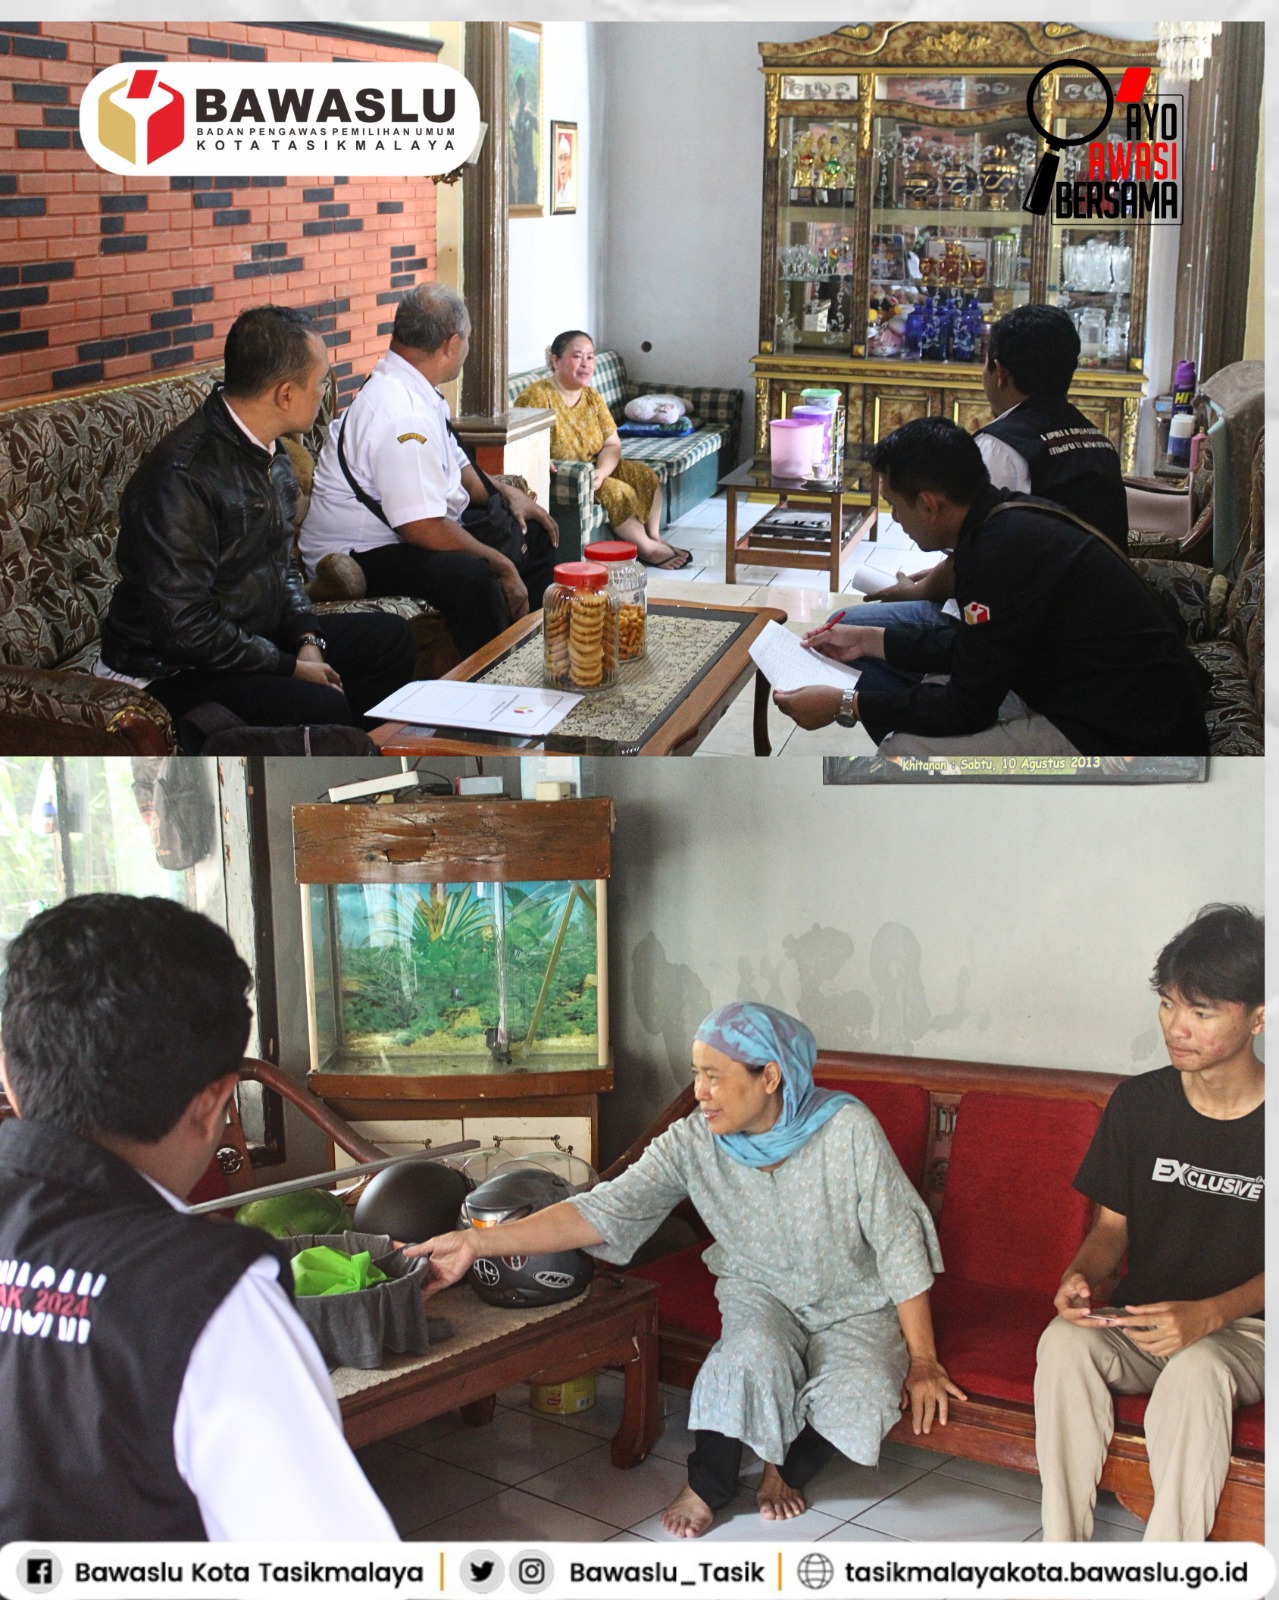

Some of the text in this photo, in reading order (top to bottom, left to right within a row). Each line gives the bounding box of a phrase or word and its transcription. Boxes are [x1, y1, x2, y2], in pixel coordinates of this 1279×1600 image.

[902, 759, 947, 772] Khitanan
[960, 758, 996, 772] Sabtu,
[1002, 757, 1017, 769] 10
[1021, 757, 1066, 772] Agustus
[1071, 756, 1101, 768] 2013
[1151, 1157, 1264, 1200] EXCLUSIVE
[538, 1273, 571, 1285] INK
[33, 1288, 90, 1318] 2024
